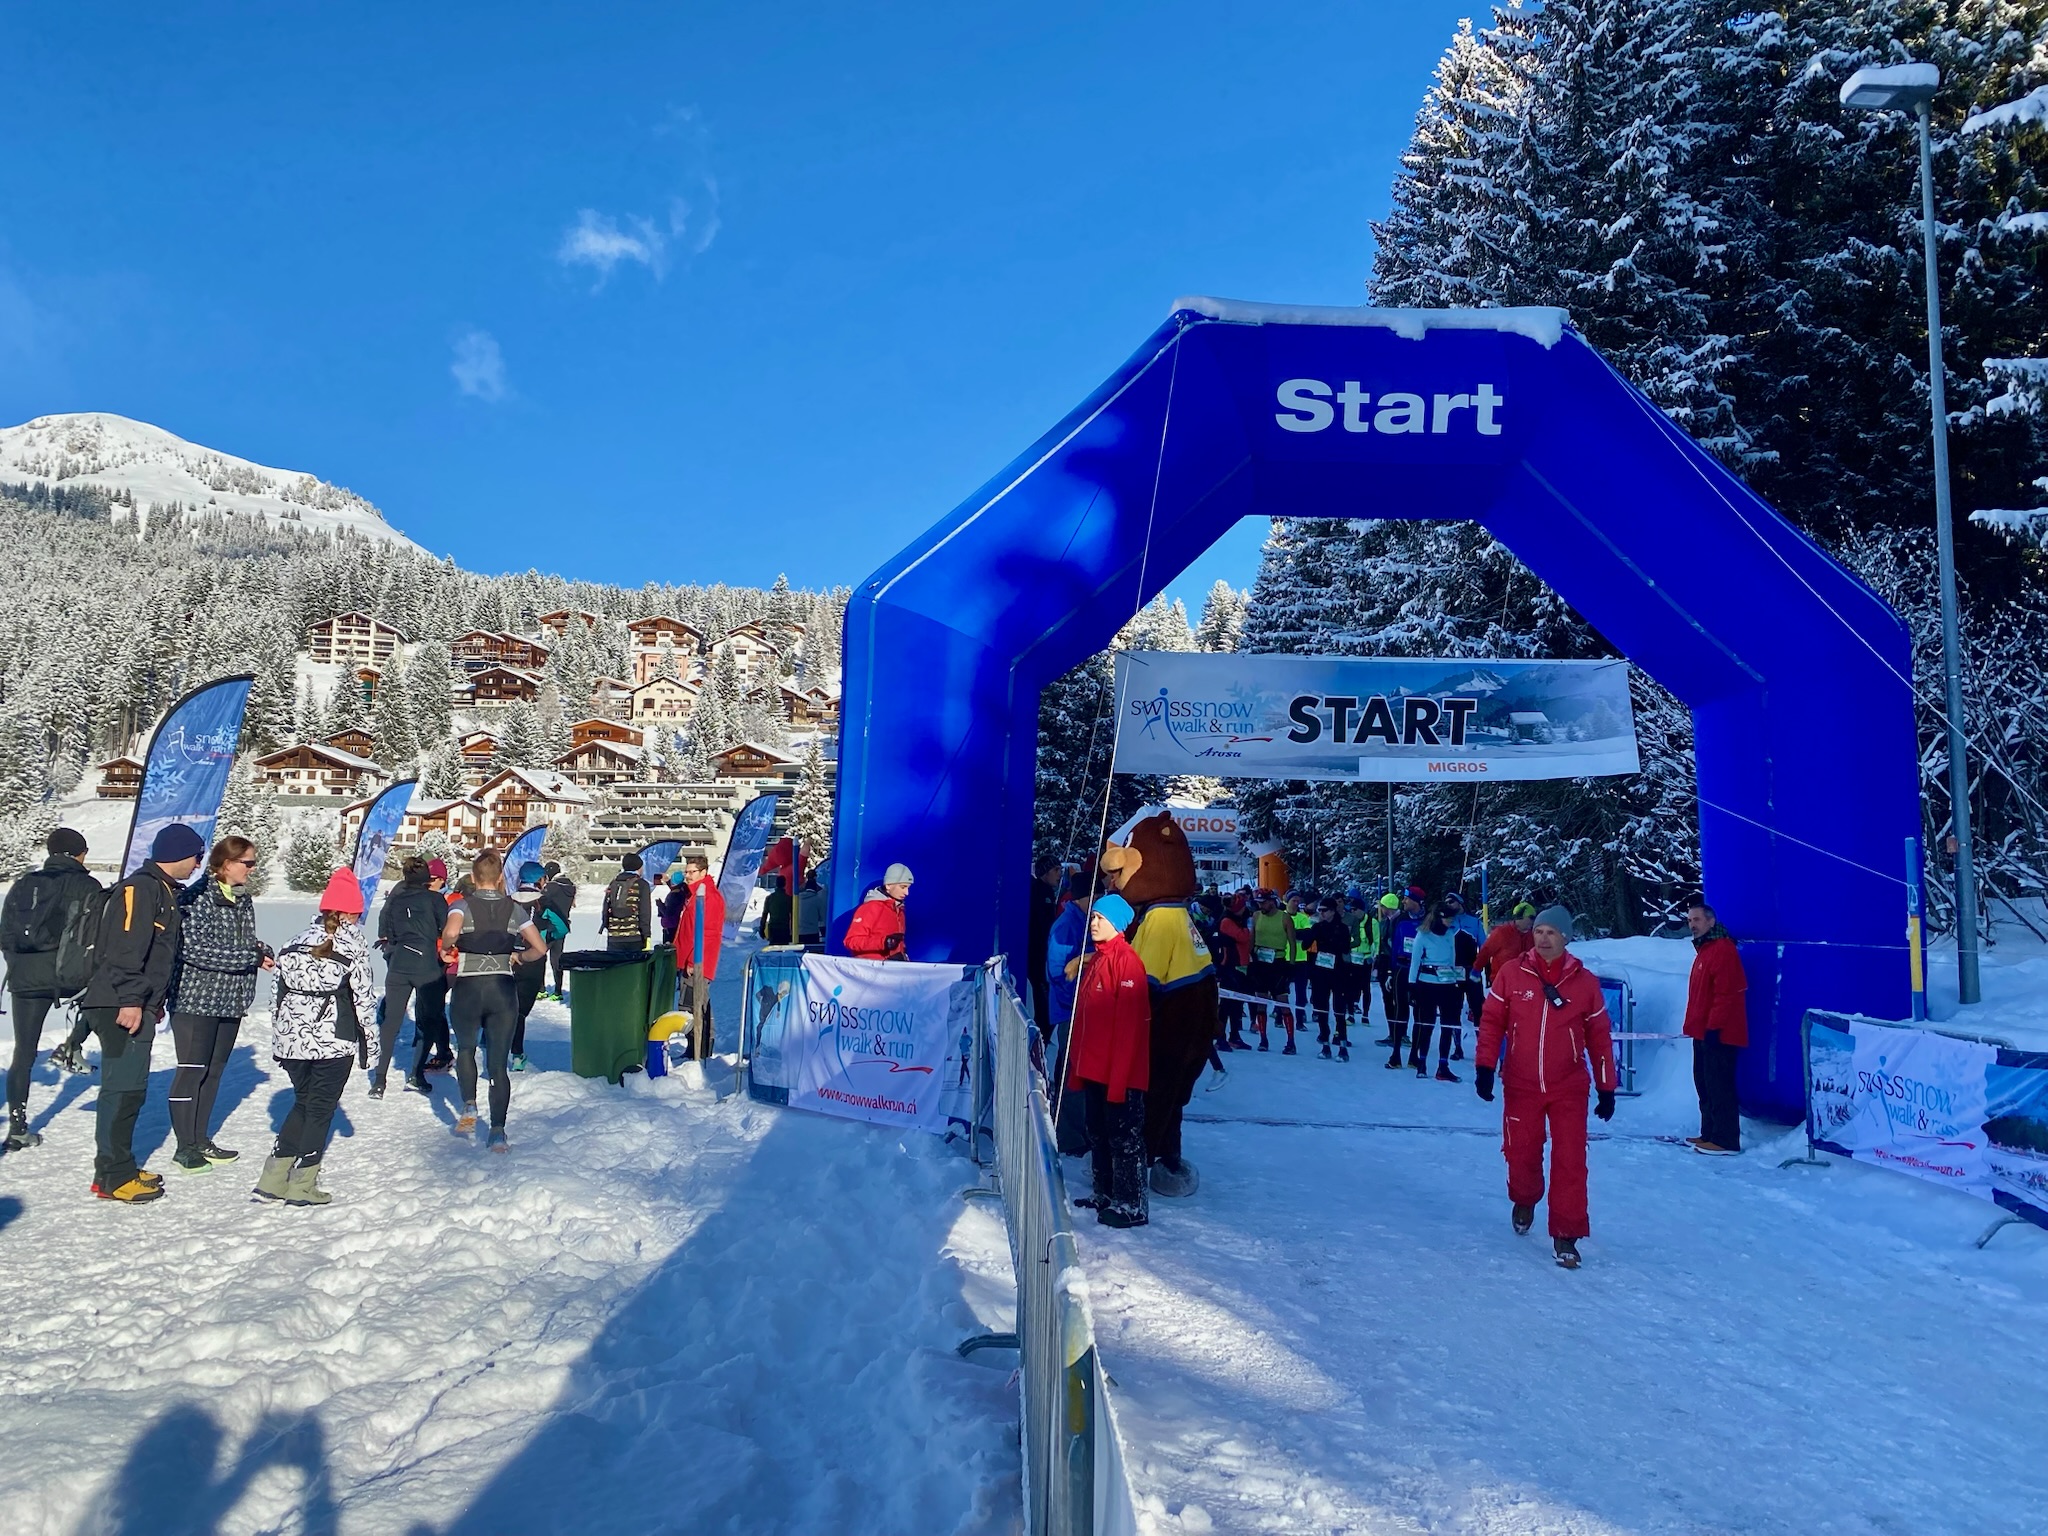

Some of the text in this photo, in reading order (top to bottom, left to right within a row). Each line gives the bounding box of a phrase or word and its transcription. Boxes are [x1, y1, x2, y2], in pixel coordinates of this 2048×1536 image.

[1275, 378, 1503, 435] Start
[1171, 718, 1254, 735] walk & run
[1286, 695, 1477, 746] START
[1428, 762, 1488, 773] MIGROS
[841, 1032, 914, 1059] walk & run
[1888, 1103, 1917, 1129] walk
[1918, 1109, 1929, 1131] &
